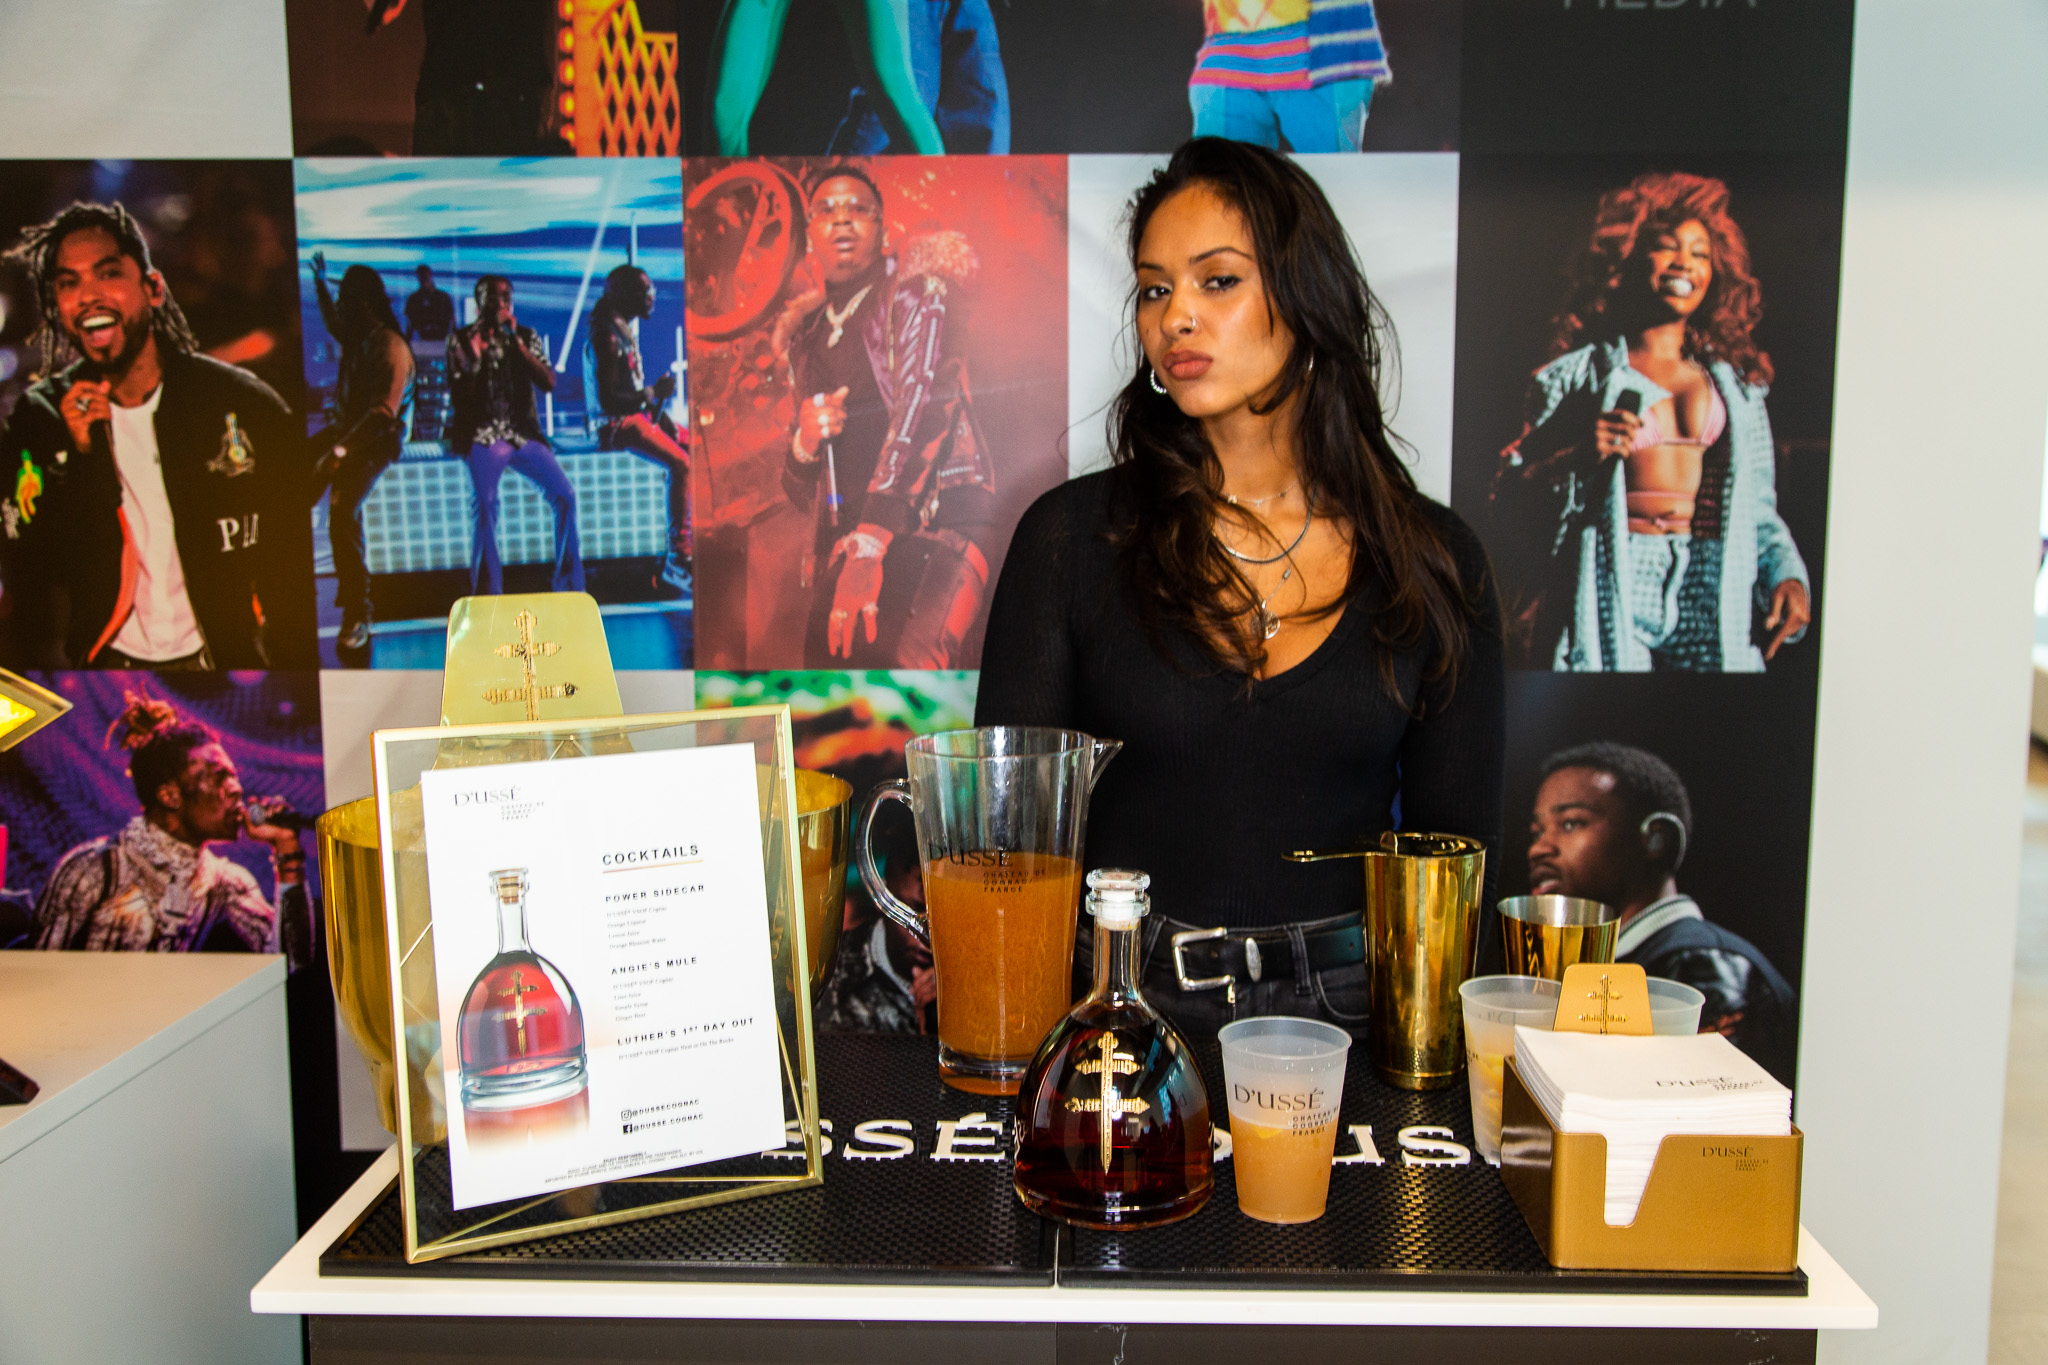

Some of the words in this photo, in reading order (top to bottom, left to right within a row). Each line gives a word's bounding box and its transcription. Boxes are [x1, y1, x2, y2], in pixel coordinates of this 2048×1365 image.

[454, 785, 519, 807] D'USSÉ
[602, 845, 699, 866] COCKTAILS
[605, 891, 648, 904] POWER
[653, 884, 705, 899] SIDECAR
[611, 961, 661, 976] ANGIE'S
[666, 956, 697, 968] MULE
[617, 1030, 677, 1047] LUTHER'S
[703, 1021, 726, 1033] DAY
[731, 1017, 754, 1028] OUT
[632, 1098, 700, 1117] @DUSSECOGNAC
[1234, 1083, 1322, 1112] D'USSÉ
[633, 1113, 704, 1132] @DUSSE.COGNAC
[1293, 1127, 1326, 1137] FRANCE
[1702, 1145, 1753, 1158] D'USSÉ
